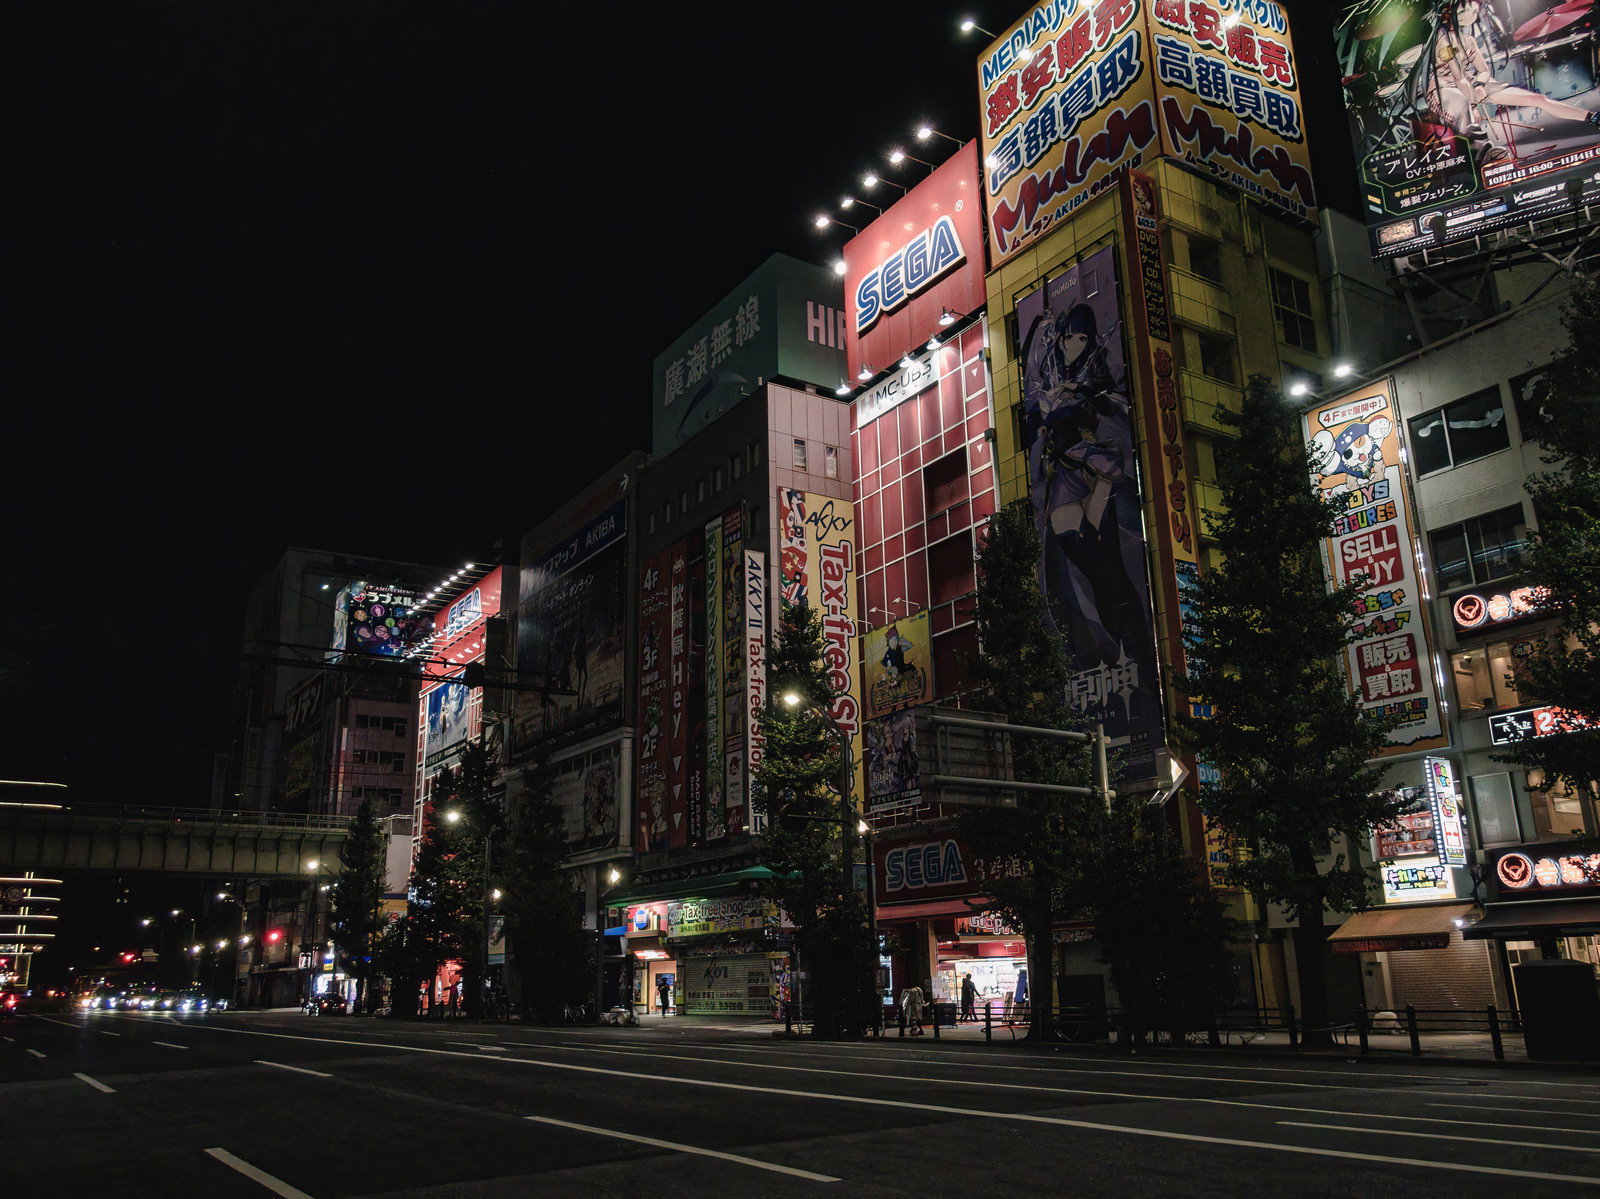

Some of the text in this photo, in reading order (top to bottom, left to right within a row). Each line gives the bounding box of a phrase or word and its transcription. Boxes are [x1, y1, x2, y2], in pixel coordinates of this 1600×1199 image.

[1154, 0, 1292, 85] 激安販売
[987, 0, 1134, 135] 激安販売
[1156, 37, 1300, 138] 高額買取
[991, 34, 1135, 195] 高額買取
[1161, 96, 1317, 208] Mulan
[1384, 144, 1451, 175] ブレイズ
[992, 102, 1157, 253] Mulan
[1185, 149, 1230, 178] ムーラン
[1230, 172, 1263, 196] AKIBA
[1010, 213, 1053, 252] ムーラン
[1054, 188, 1089, 222] AKIBA
[1139, 231, 1157, 245] DVD
[855, 215, 965, 333] SEGA
[1141, 255, 1161, 270] ゲーム
[1146, 267, 1159, 279] CD
[1145, 290, 1165, 304] アニメ
[1346, 478, 1390, 511] OYS
[585, 514, 616, 549] AKIBA
[805, 500, 853, 542] AKKY
[1333, 500, 1398, 537] FIGURES
[1343, 530, 1397, 563] SELL
[1367, 556, 1375, 564] &
[643, 567, 660, 591] 4F
[747, 555, 764, 616] AKKY
[446, 587, 482, 640] SEGA
[820, 541, 858, 699] Tax-free
[642, 645, 659, 671] 3F
[1362, 639, 1411, 668] 販売
[1384, 664, 1392, 672] &
[749, 632, 765, 718] Tax-free
[1366, 667, 1416, 699] 買取
[642, 732, 658, 760] 2F
[885, 838, 968, 892] SEGA
